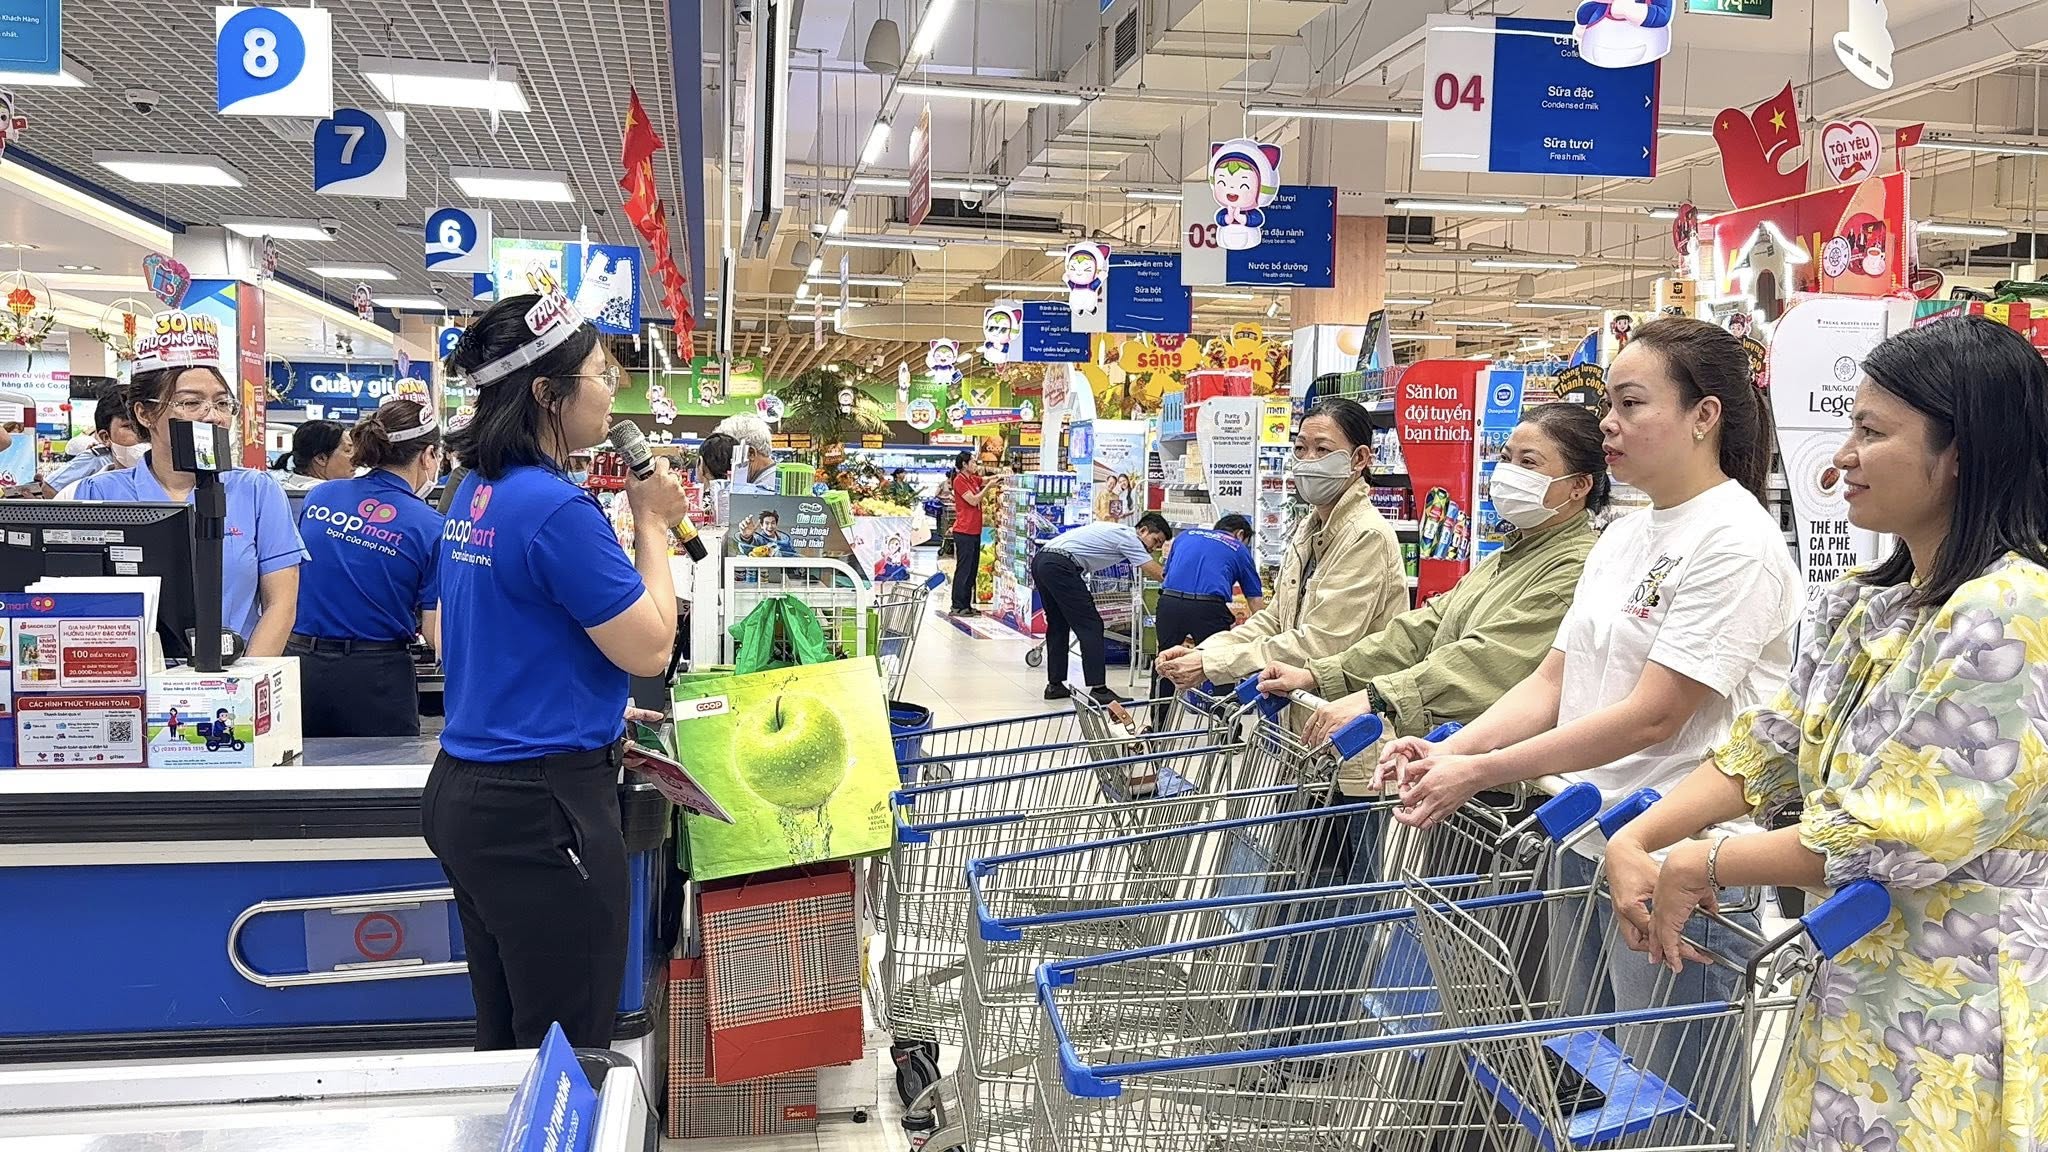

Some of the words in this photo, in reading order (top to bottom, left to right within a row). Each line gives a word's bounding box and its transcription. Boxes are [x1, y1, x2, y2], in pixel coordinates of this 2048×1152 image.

[242, 27, 279, 78] 8
[1434, 72, 1484, 112] 04
[1548, 85, 1571, 98] Sữa
[1573, 86, 1594, 100] đặc
[1541, 100, 1584, 110] Condensed
[1585, 101, 1599, 110] milk
[334, 125, 365, 165] 7
[1543, 137, 1566, 149] Sữa
[1569, 138, 1594, 150] tươi
[1829, 141, 1848, 154] TÔI
[1849, 137, 1870, 151] YÊU
[1550, 153, 1571, 161] Fresh
[1572, 153, 1586, 161] milk
[1832, 154, 1851, 167] VIỆT
[1852, 151, 1872, 163] NAM
[1280, 194, 1296, 202] tươi
[440, 220, 462, 250] 6
[1188, 223, 1219, 248] 03
[1270, 228, 1284, 238] đậu
[1286, 228, 1304, 237] nành
[1164, 260, 1173, 268] bé
[1248, 261, 1270, 270] Nước
[1271, 261, 1281, 270] bổ
[1283, 261, 1308, 272] dưỡng
[1135, 286, 1149, 294] Sữa
[1150, 286, 1161, 295] bột
[155, 313, 188, 334] 30
[136, 332, 194, 354] THƯƠNG
[1161, 336, 1178, 346] TỐT
[1582, 365, 1603, 380] lượng
[35, 381, 46, 389] có
[310, 372, 364, 398] Quầy
[1405, 383, 1432, 400] Săn
[1434, 384, 1458, 400] lon
[1404, 405, 1430, 424] đội
[1430, 403, 1472, 424] tuyển
[1404, 425, 1431, 444] bạn
[1433, 425, 1473, 441] thích.
[1219, 487, 1242, 496] 24H
[306, 504, 404, 545] co.opmart
[326, 527, 346, 540] bạn
[346, 534, 361, 545] của
[362, 540, 377, 551] mọi
[378, 543, 397, 557] nhà
[475, 555, 492, 567] nhà
[1836, 552, 1857, 567] TAN
[71, 650, 89, 659] 100
